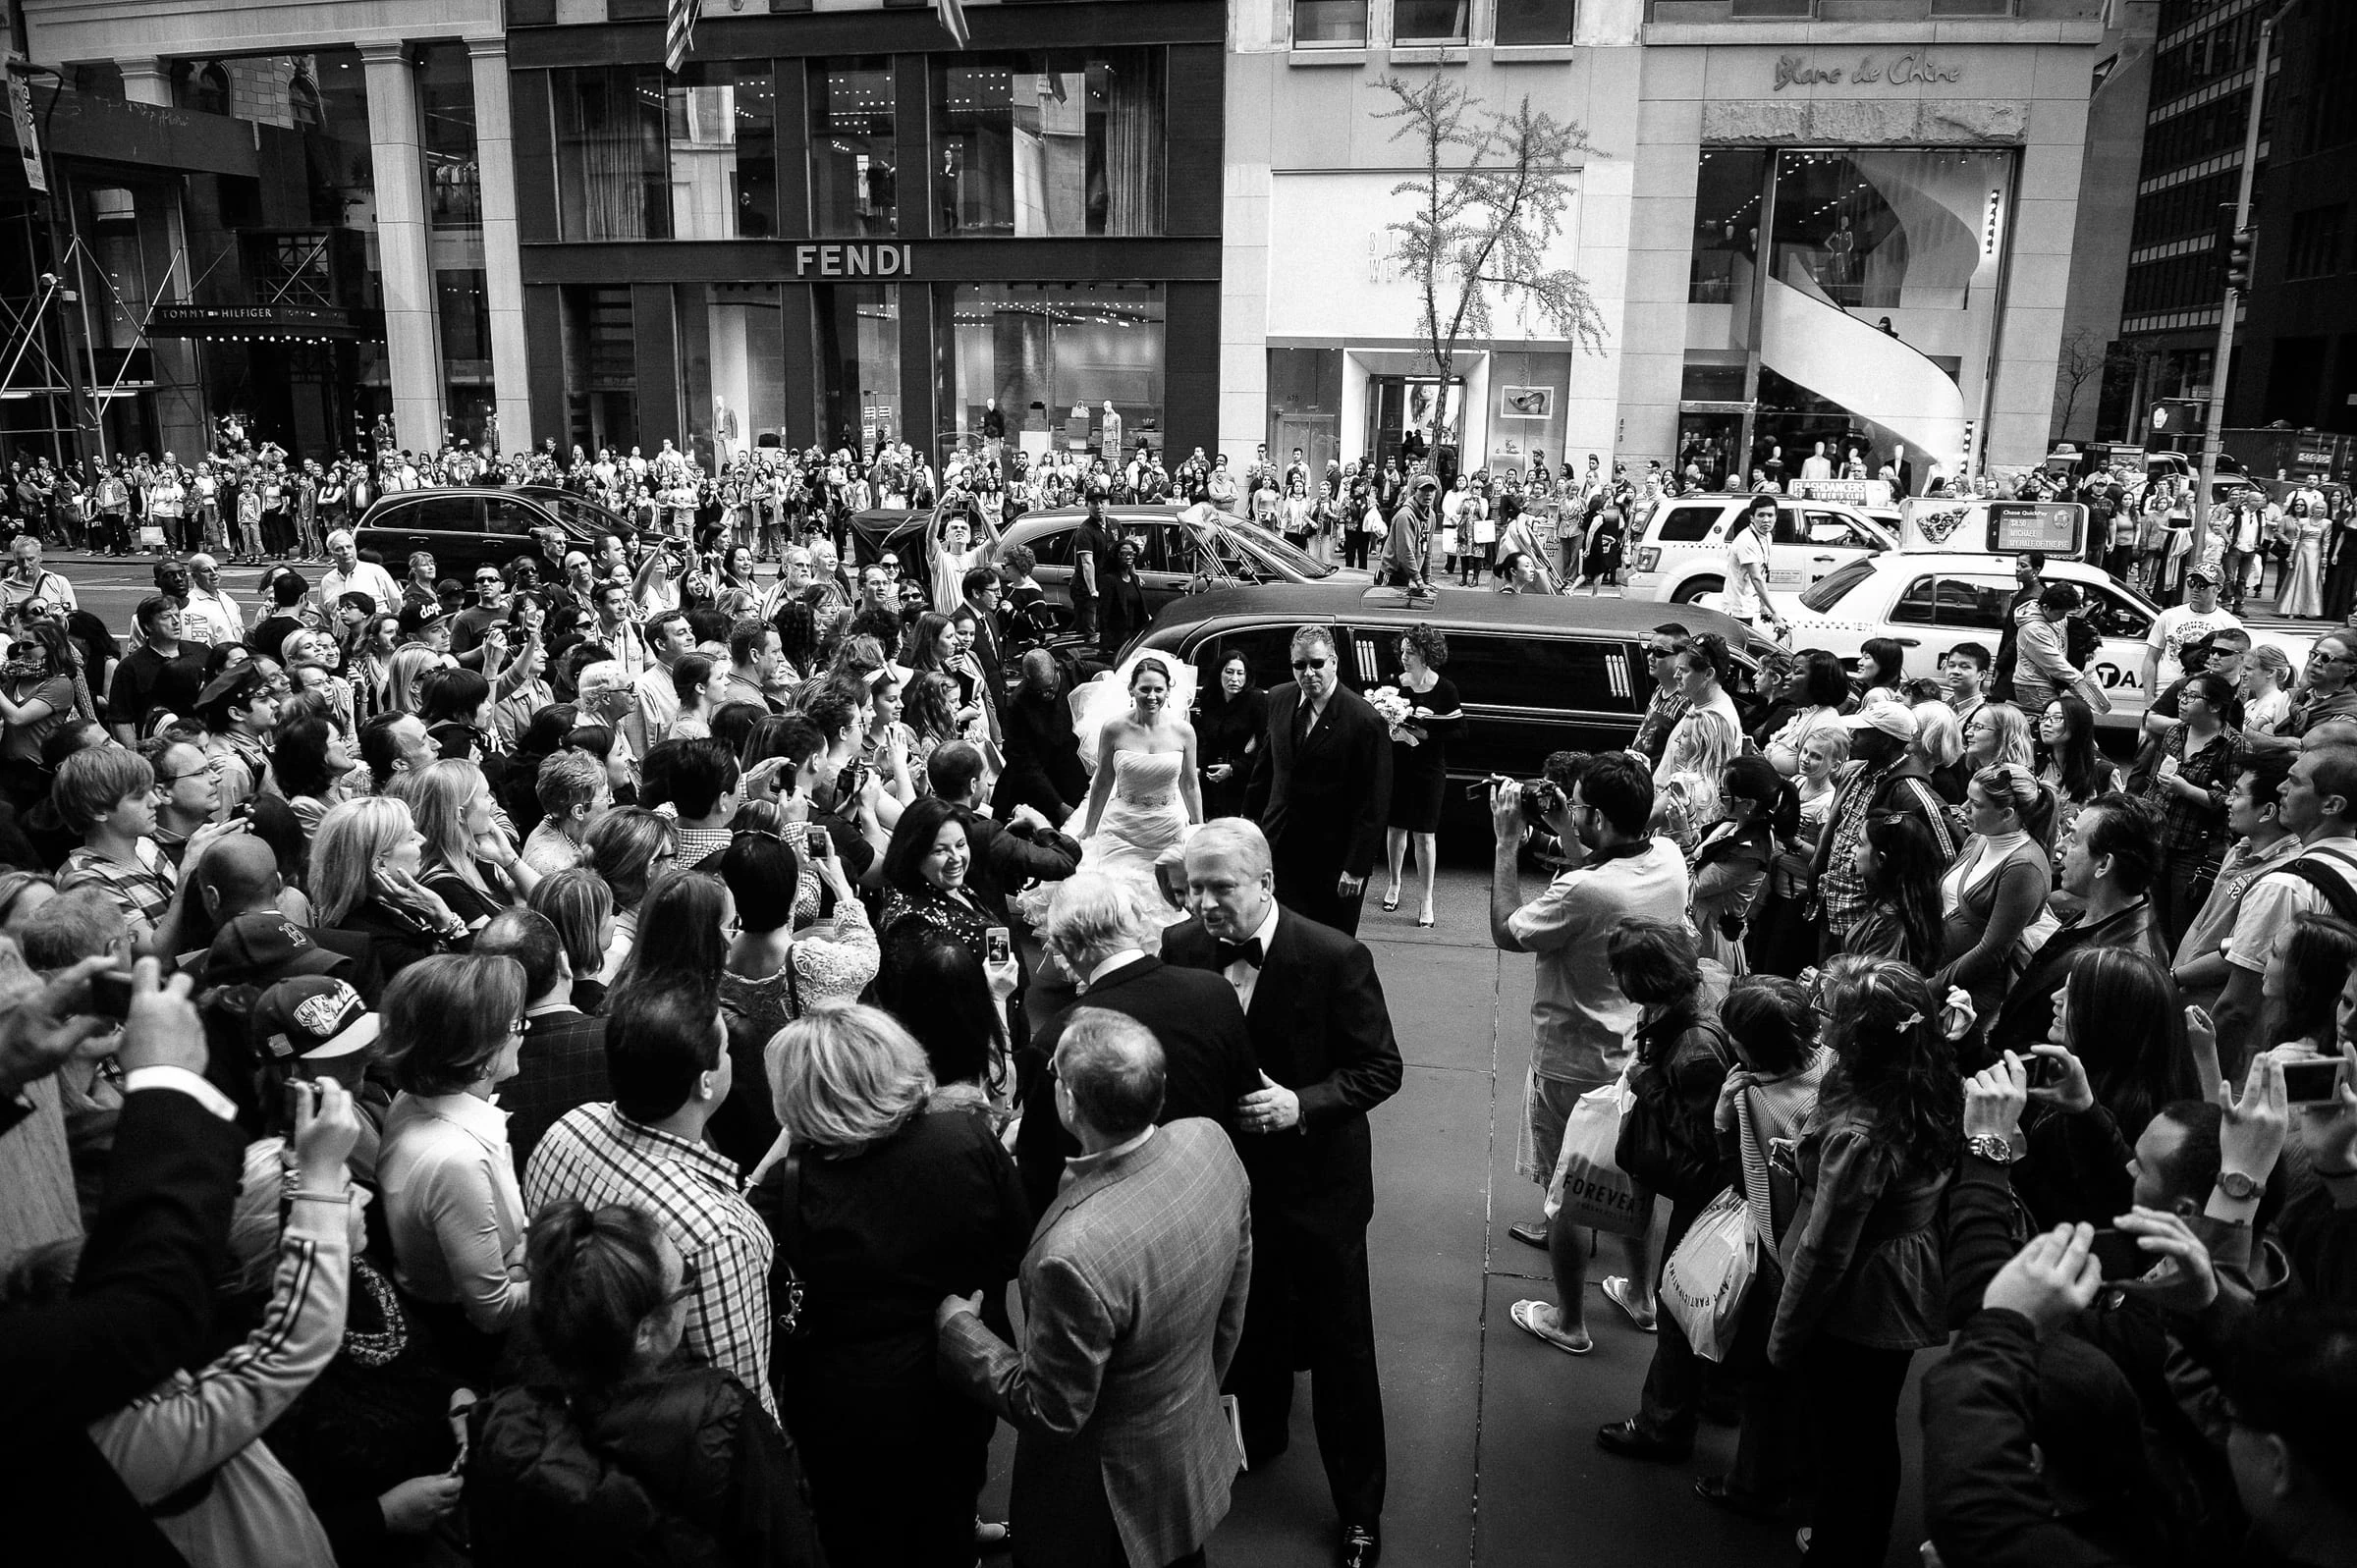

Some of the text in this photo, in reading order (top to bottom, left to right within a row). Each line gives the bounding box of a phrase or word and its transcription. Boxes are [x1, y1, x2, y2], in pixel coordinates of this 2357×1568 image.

[1774, 52, 1960, 91] Blanc de Chine
[796, 244, 911, 275] FENDI
[161, 309, 205, 319] TOMMY
[221, 308, 273, 318] HILFIGER
[1794, 481, 1866, 492] FLASHDANCERS
[2096, 663, 2145, 689] TA
[2226, 882, 2240, 900] 92
[1562, 1174, 1635, 1215] FOREVER
